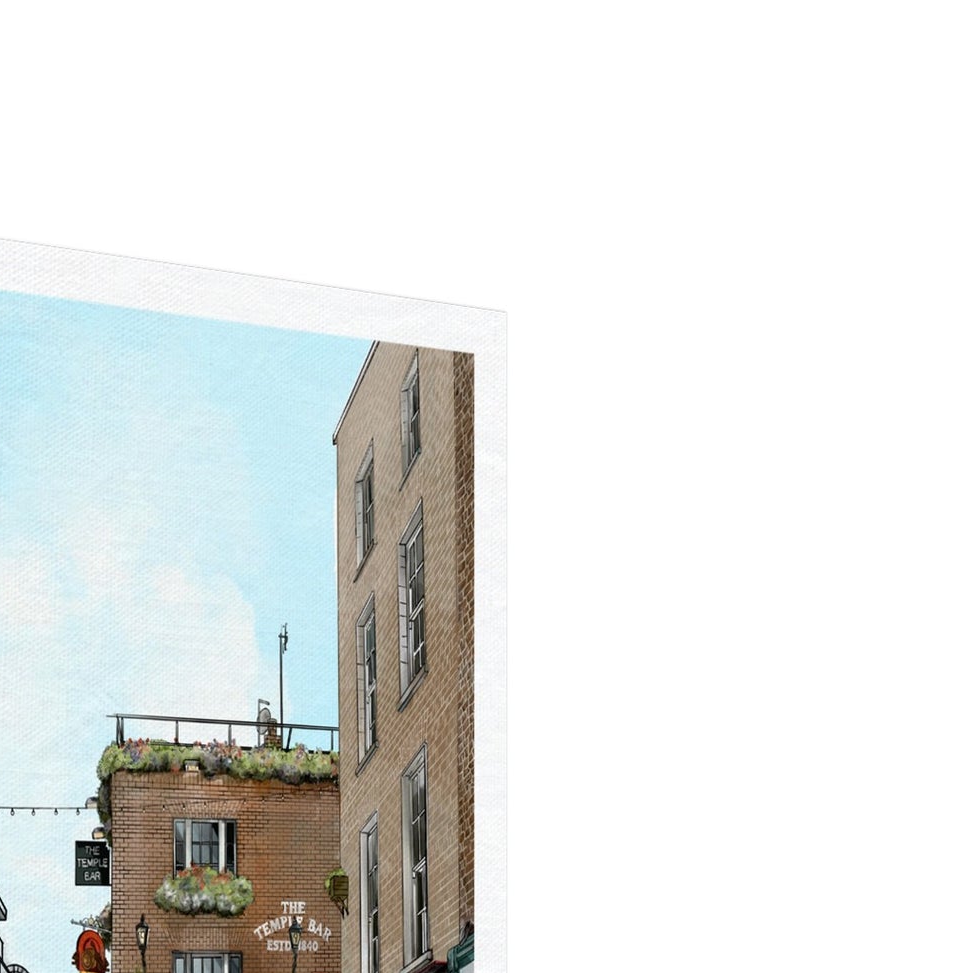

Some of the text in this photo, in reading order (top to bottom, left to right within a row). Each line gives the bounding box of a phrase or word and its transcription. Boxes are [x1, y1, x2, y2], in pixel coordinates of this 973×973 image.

[85, 845, 100, 856] THE
[77, 857, 108, 868] TEMPLE
[280, 901, 306, 914] THE
[307, 918, 332, 942] BAR
